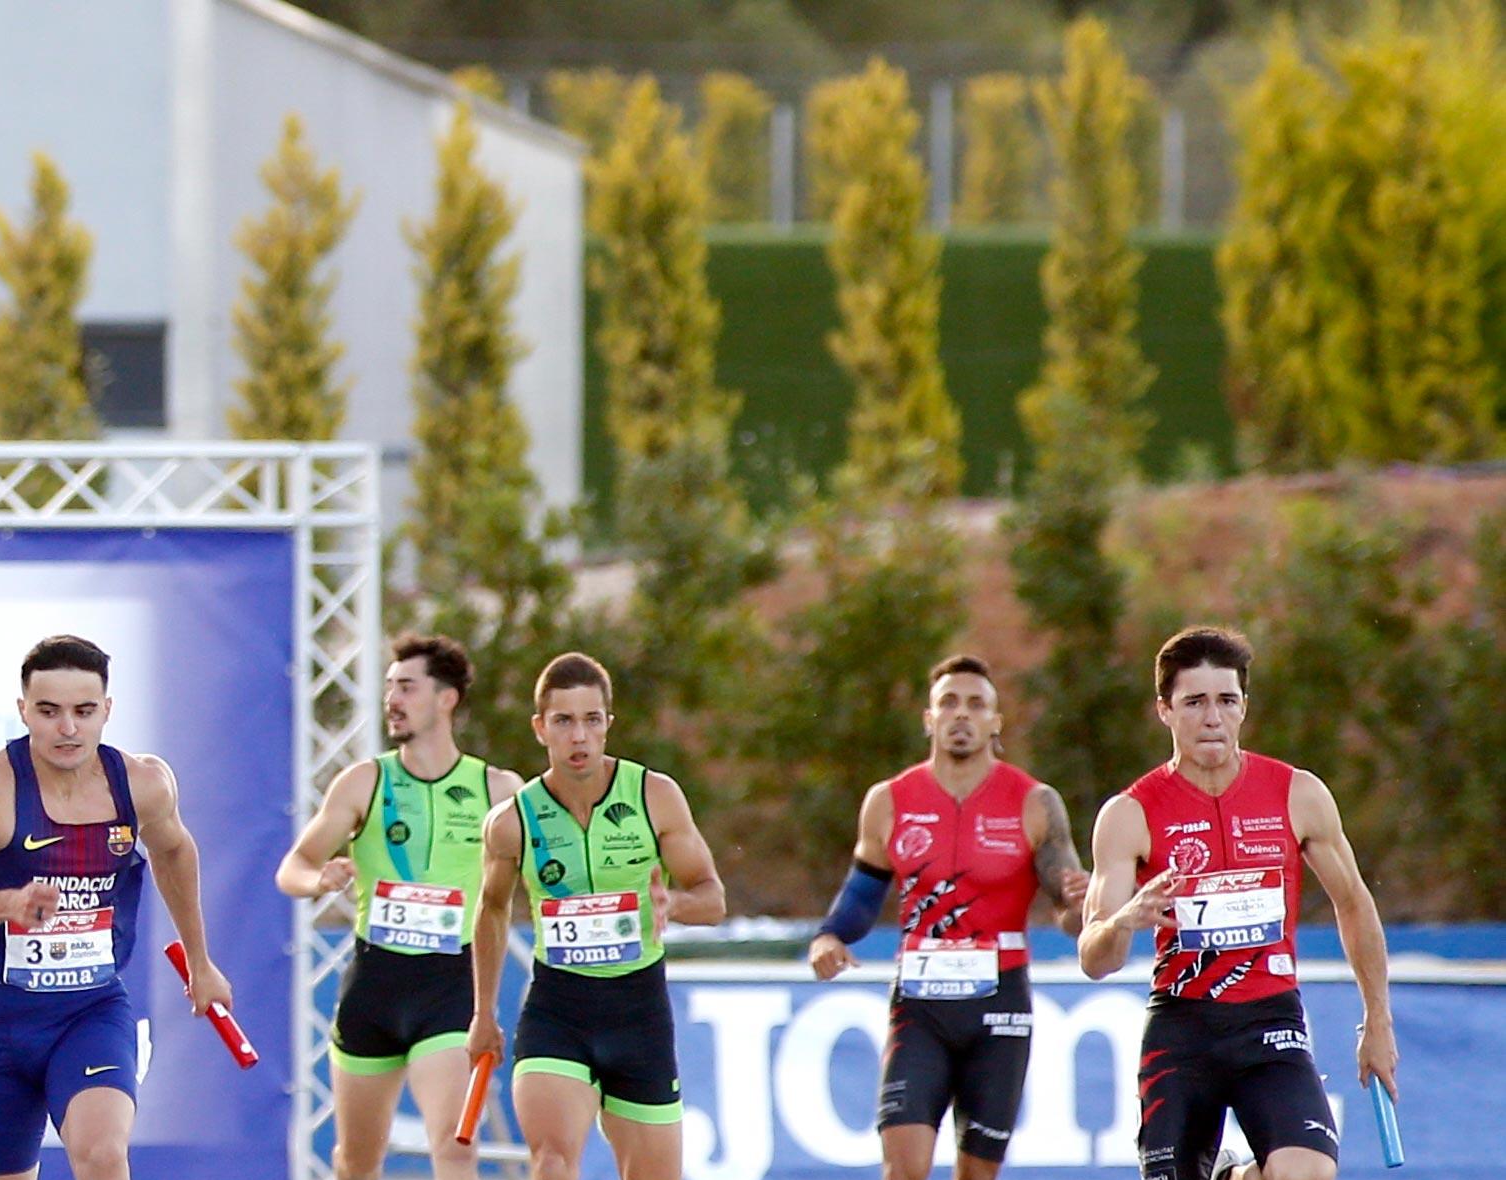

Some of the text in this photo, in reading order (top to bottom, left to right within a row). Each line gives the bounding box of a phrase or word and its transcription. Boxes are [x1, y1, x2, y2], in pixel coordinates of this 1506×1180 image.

[381, 903, 406, 925] 13
[1192, 900, 1208, 925] 7
[550, 921, 577, 943] 13
[1200, 927, 1266, 949] Joma
[26, 939, 43, 964] 3
[918, 955, 929, 977] 7
[28, 968, 94, 989] Joma
